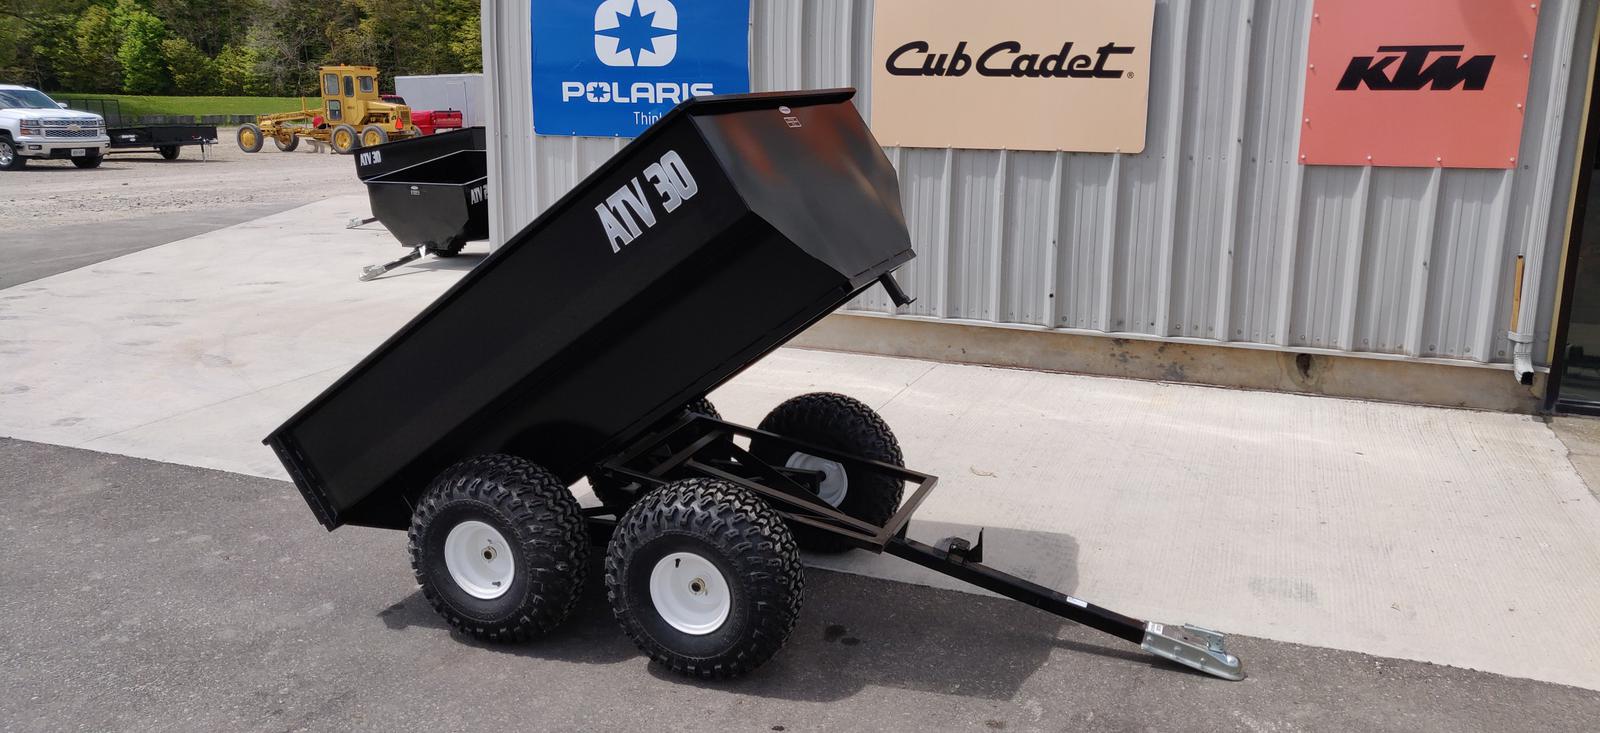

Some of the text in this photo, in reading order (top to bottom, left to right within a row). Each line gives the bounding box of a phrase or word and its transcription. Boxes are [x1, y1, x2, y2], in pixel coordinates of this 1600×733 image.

[885, 40, 1135, 79] Cub Cadet
[1335, 45, 1496, 91] KTM
[561, 81, 714, 104] POLARIS
[633, 111, 662, 126] Thin
[360, 152, 371, 166] ATV
[471, 186, 482, 204] ATV
[594, 149, 699, 254] ATV 30
